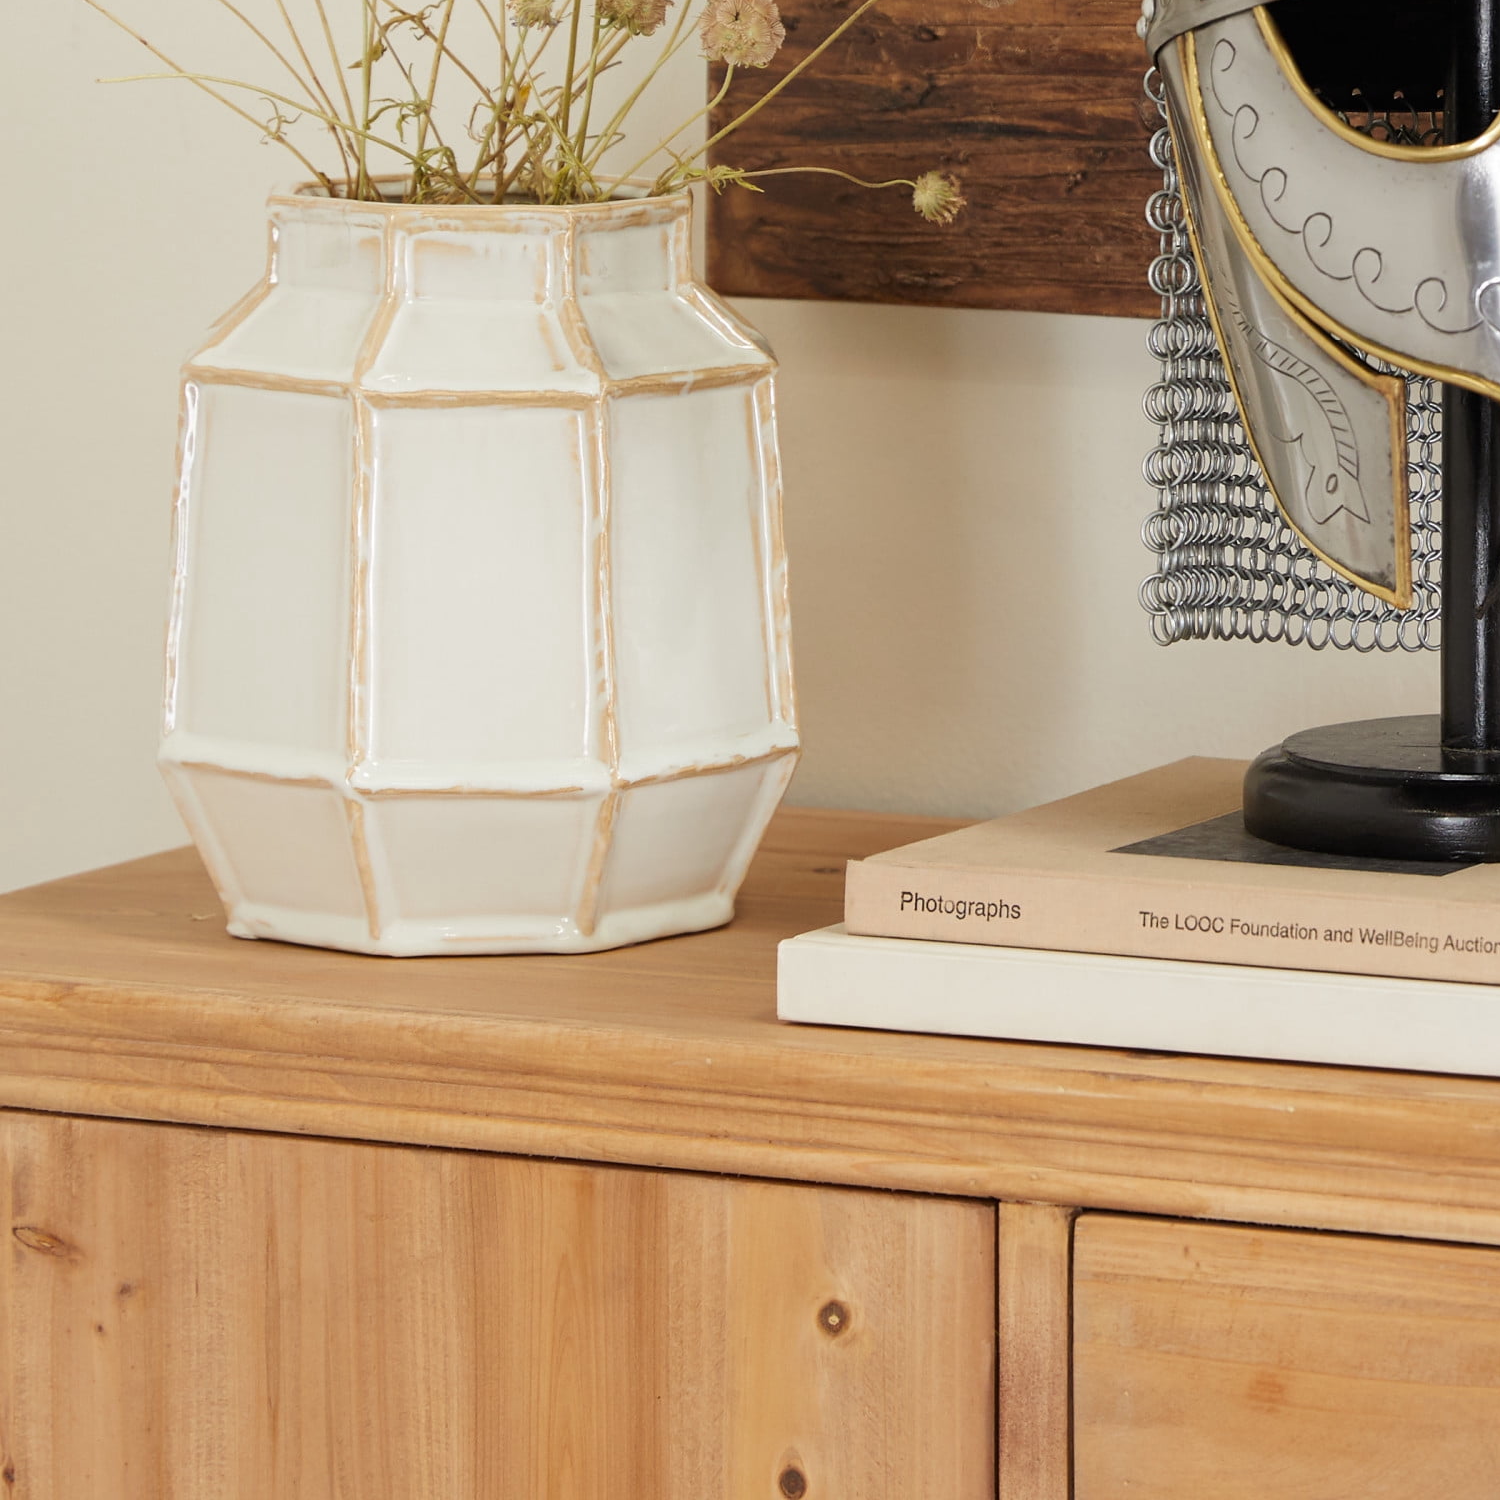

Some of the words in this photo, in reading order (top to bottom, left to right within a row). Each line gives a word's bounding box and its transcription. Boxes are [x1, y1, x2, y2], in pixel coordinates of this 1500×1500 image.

[900, 891, 1021, 922] Photographs
[1139, 911, 1169, 929] The
[1175, 914, 1224, 934] LOOC
[1230, 918, 1318, 941] Foundation
[1323, 927, 1353, 944] and
[1358, 928, 1439, 953] WellBeing
